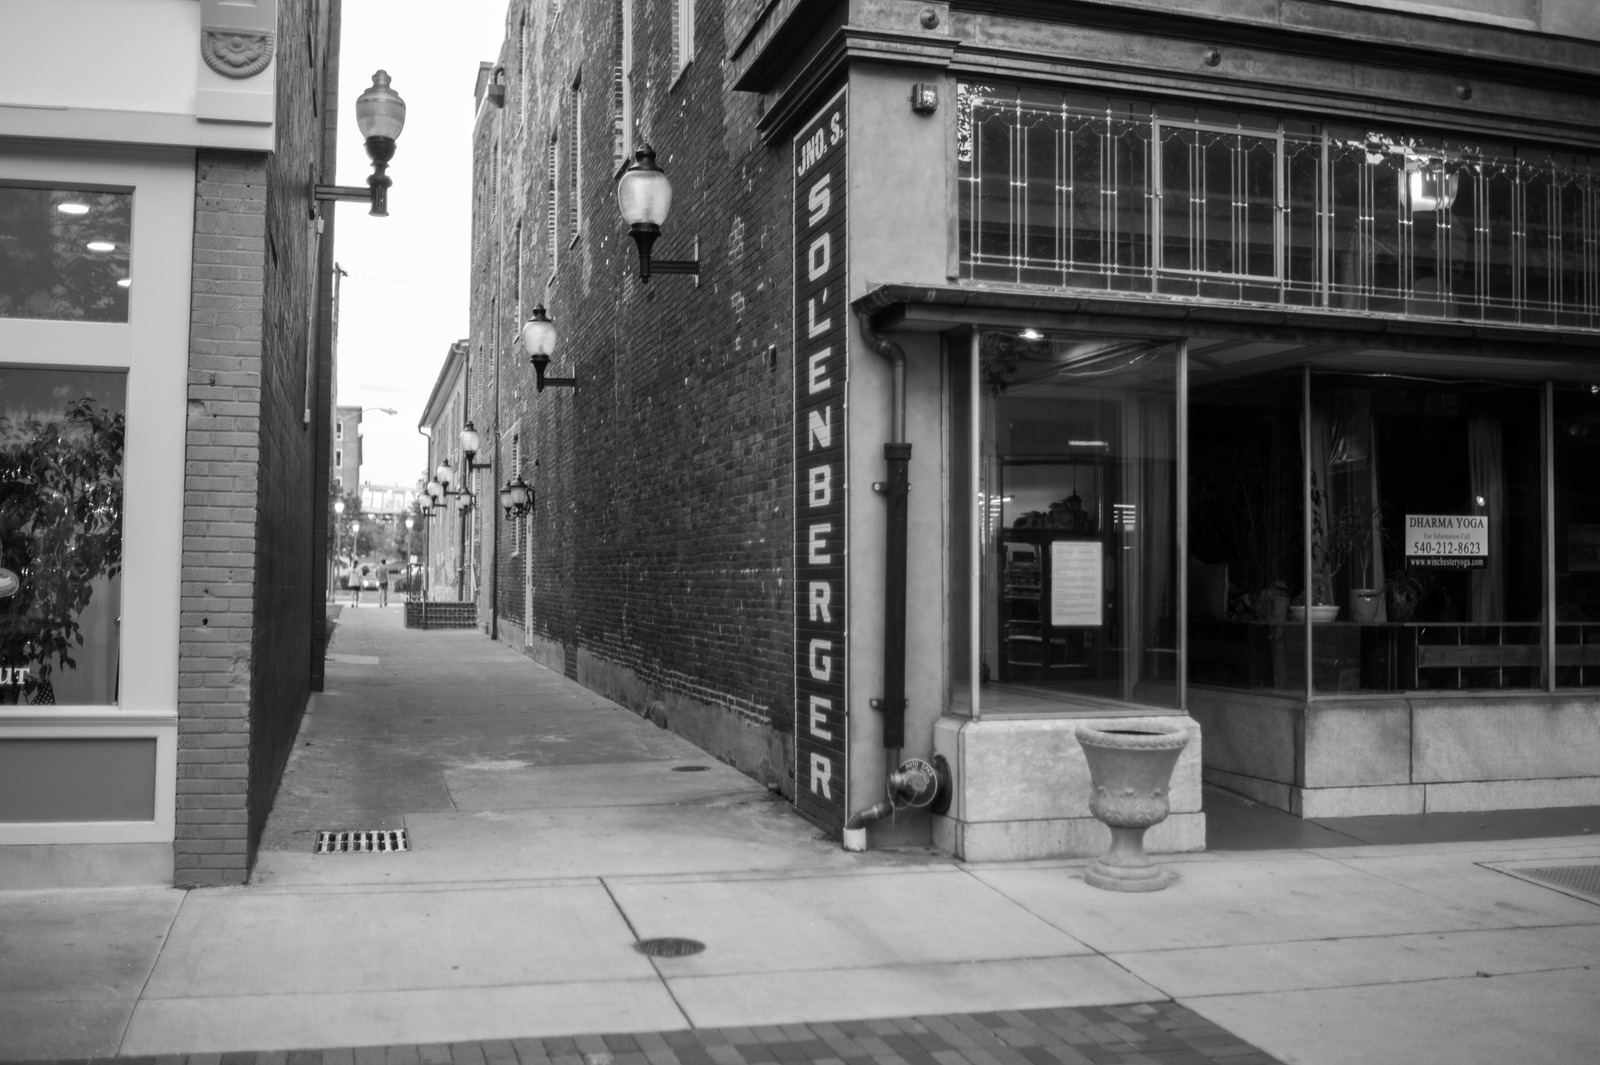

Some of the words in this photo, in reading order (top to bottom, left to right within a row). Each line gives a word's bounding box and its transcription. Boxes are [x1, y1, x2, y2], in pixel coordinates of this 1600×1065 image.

[1409, 517, 1453, 528] DHARMA
[1456, 518, 1484, 528] YOGA
[1413, 541, 1481, 554] 540-212-8623
[1410, 557, 1484, 568] www.winchesteryoga.com
[905, 760, 919, 769] AUTO
